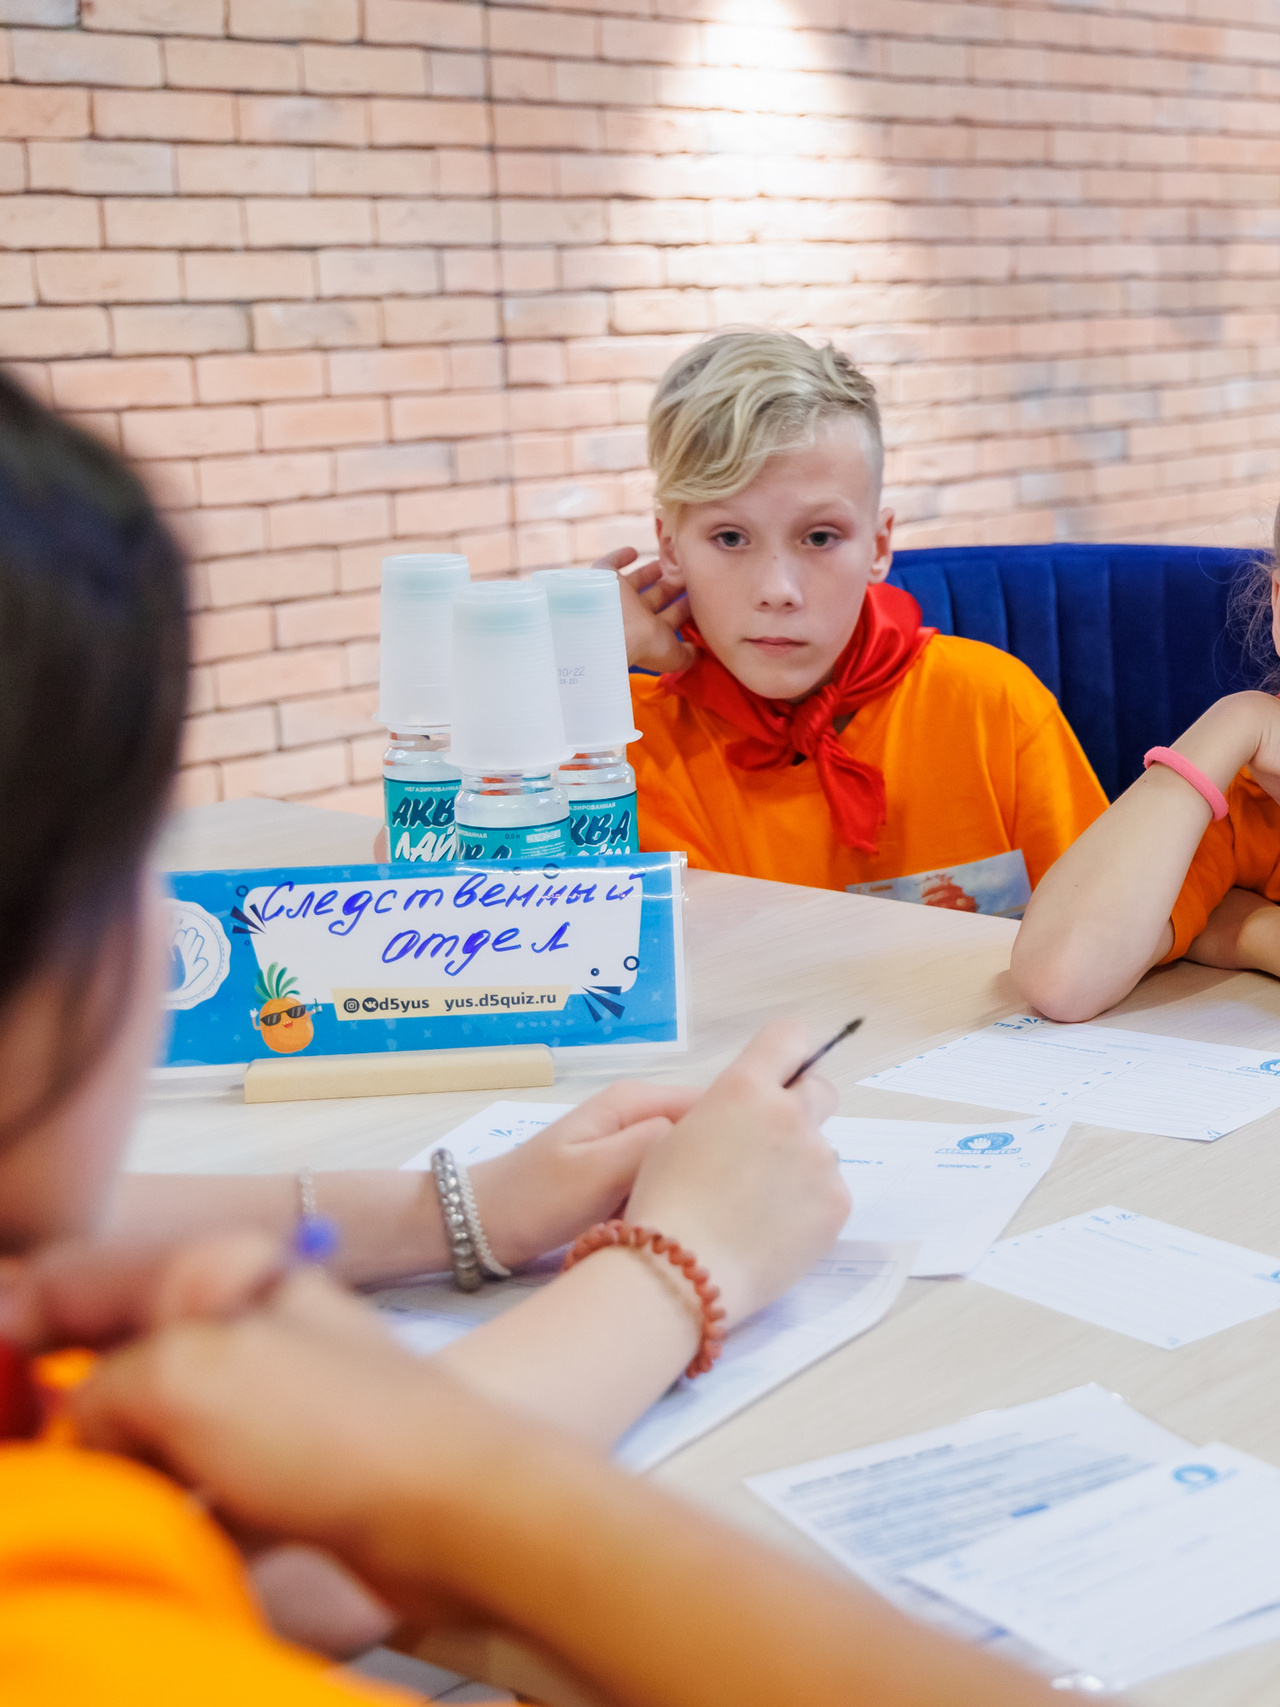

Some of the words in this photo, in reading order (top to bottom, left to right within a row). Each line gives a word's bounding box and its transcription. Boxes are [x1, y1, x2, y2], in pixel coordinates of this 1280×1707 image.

[392, 797, 455, 828] АКВ
[570, 809, 632, 847] КВА
[395, 825, 457, 862] ЛАЙ
[261, 873, 646, 936] Следственный
[445, 992, 557, 1014] yus.d5quiz.ru
